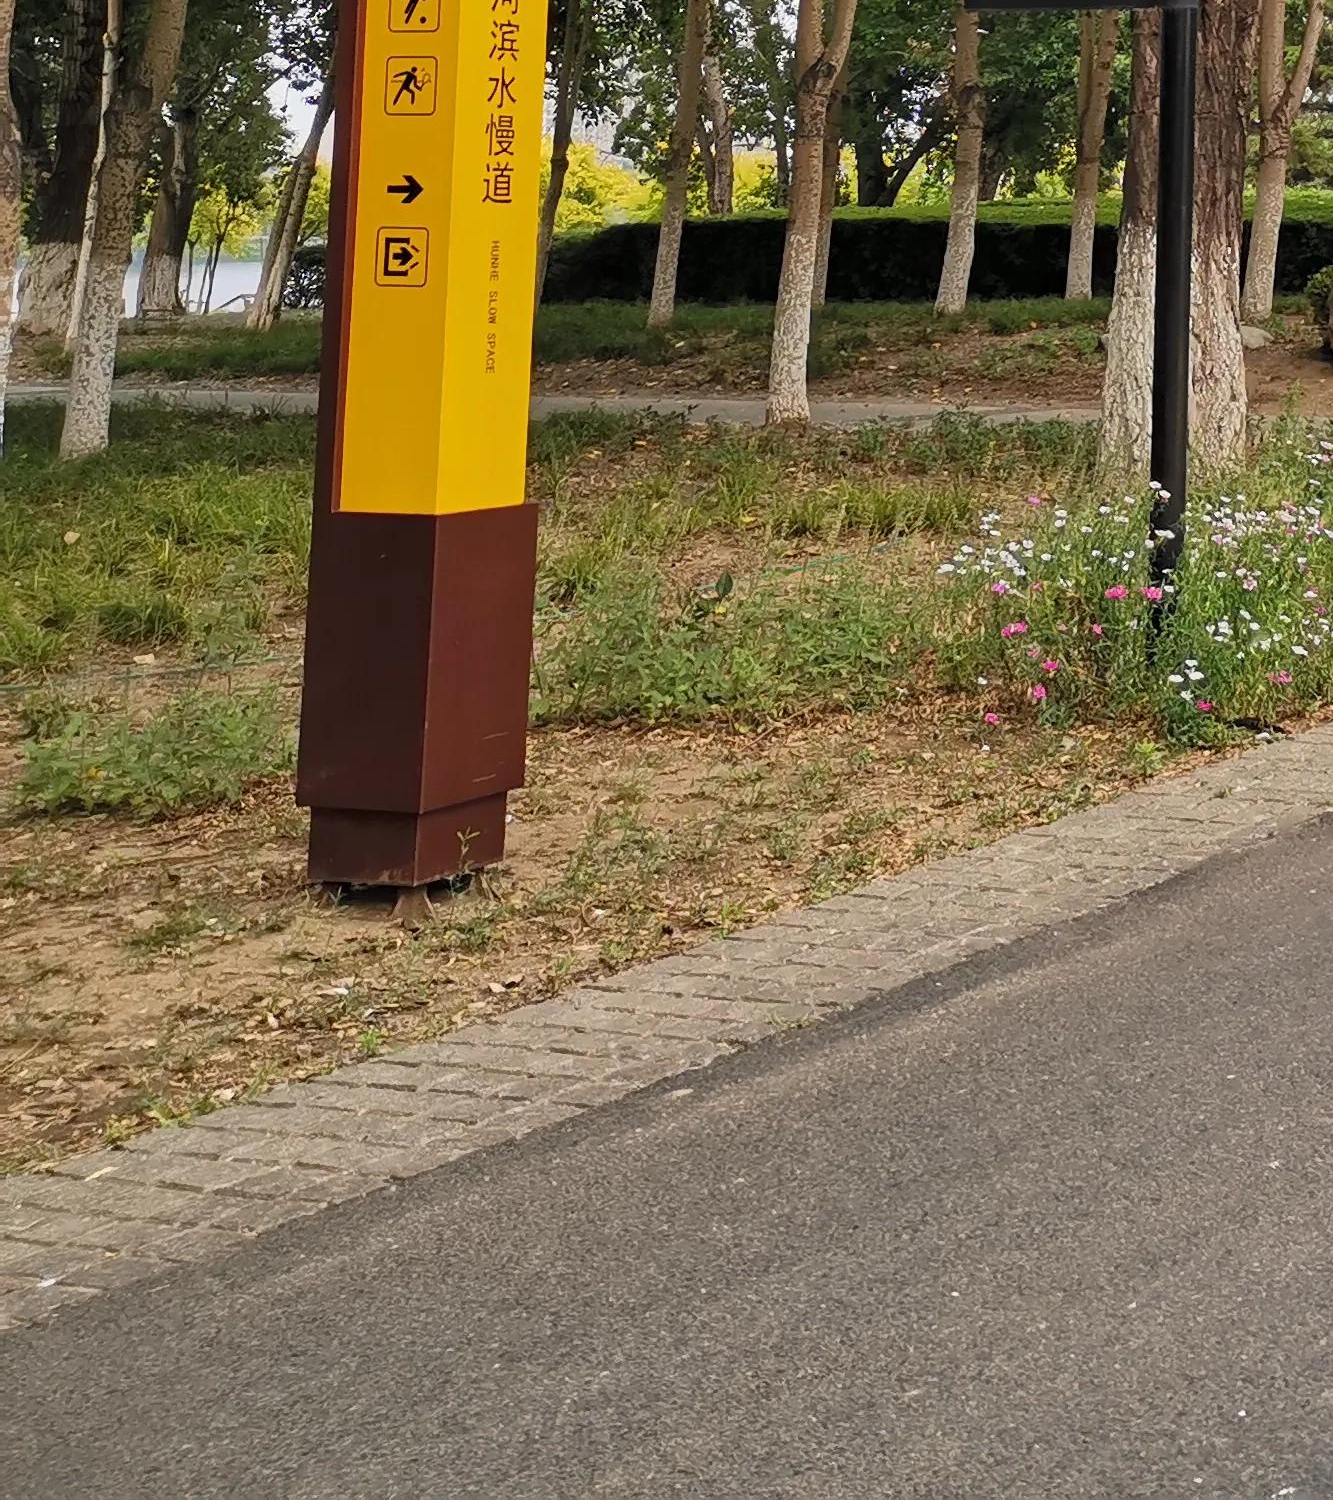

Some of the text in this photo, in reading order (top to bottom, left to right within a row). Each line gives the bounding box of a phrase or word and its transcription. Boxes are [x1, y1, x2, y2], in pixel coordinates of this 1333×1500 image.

[485, 240, 500, 374] HUNHE SLOW SPACE
